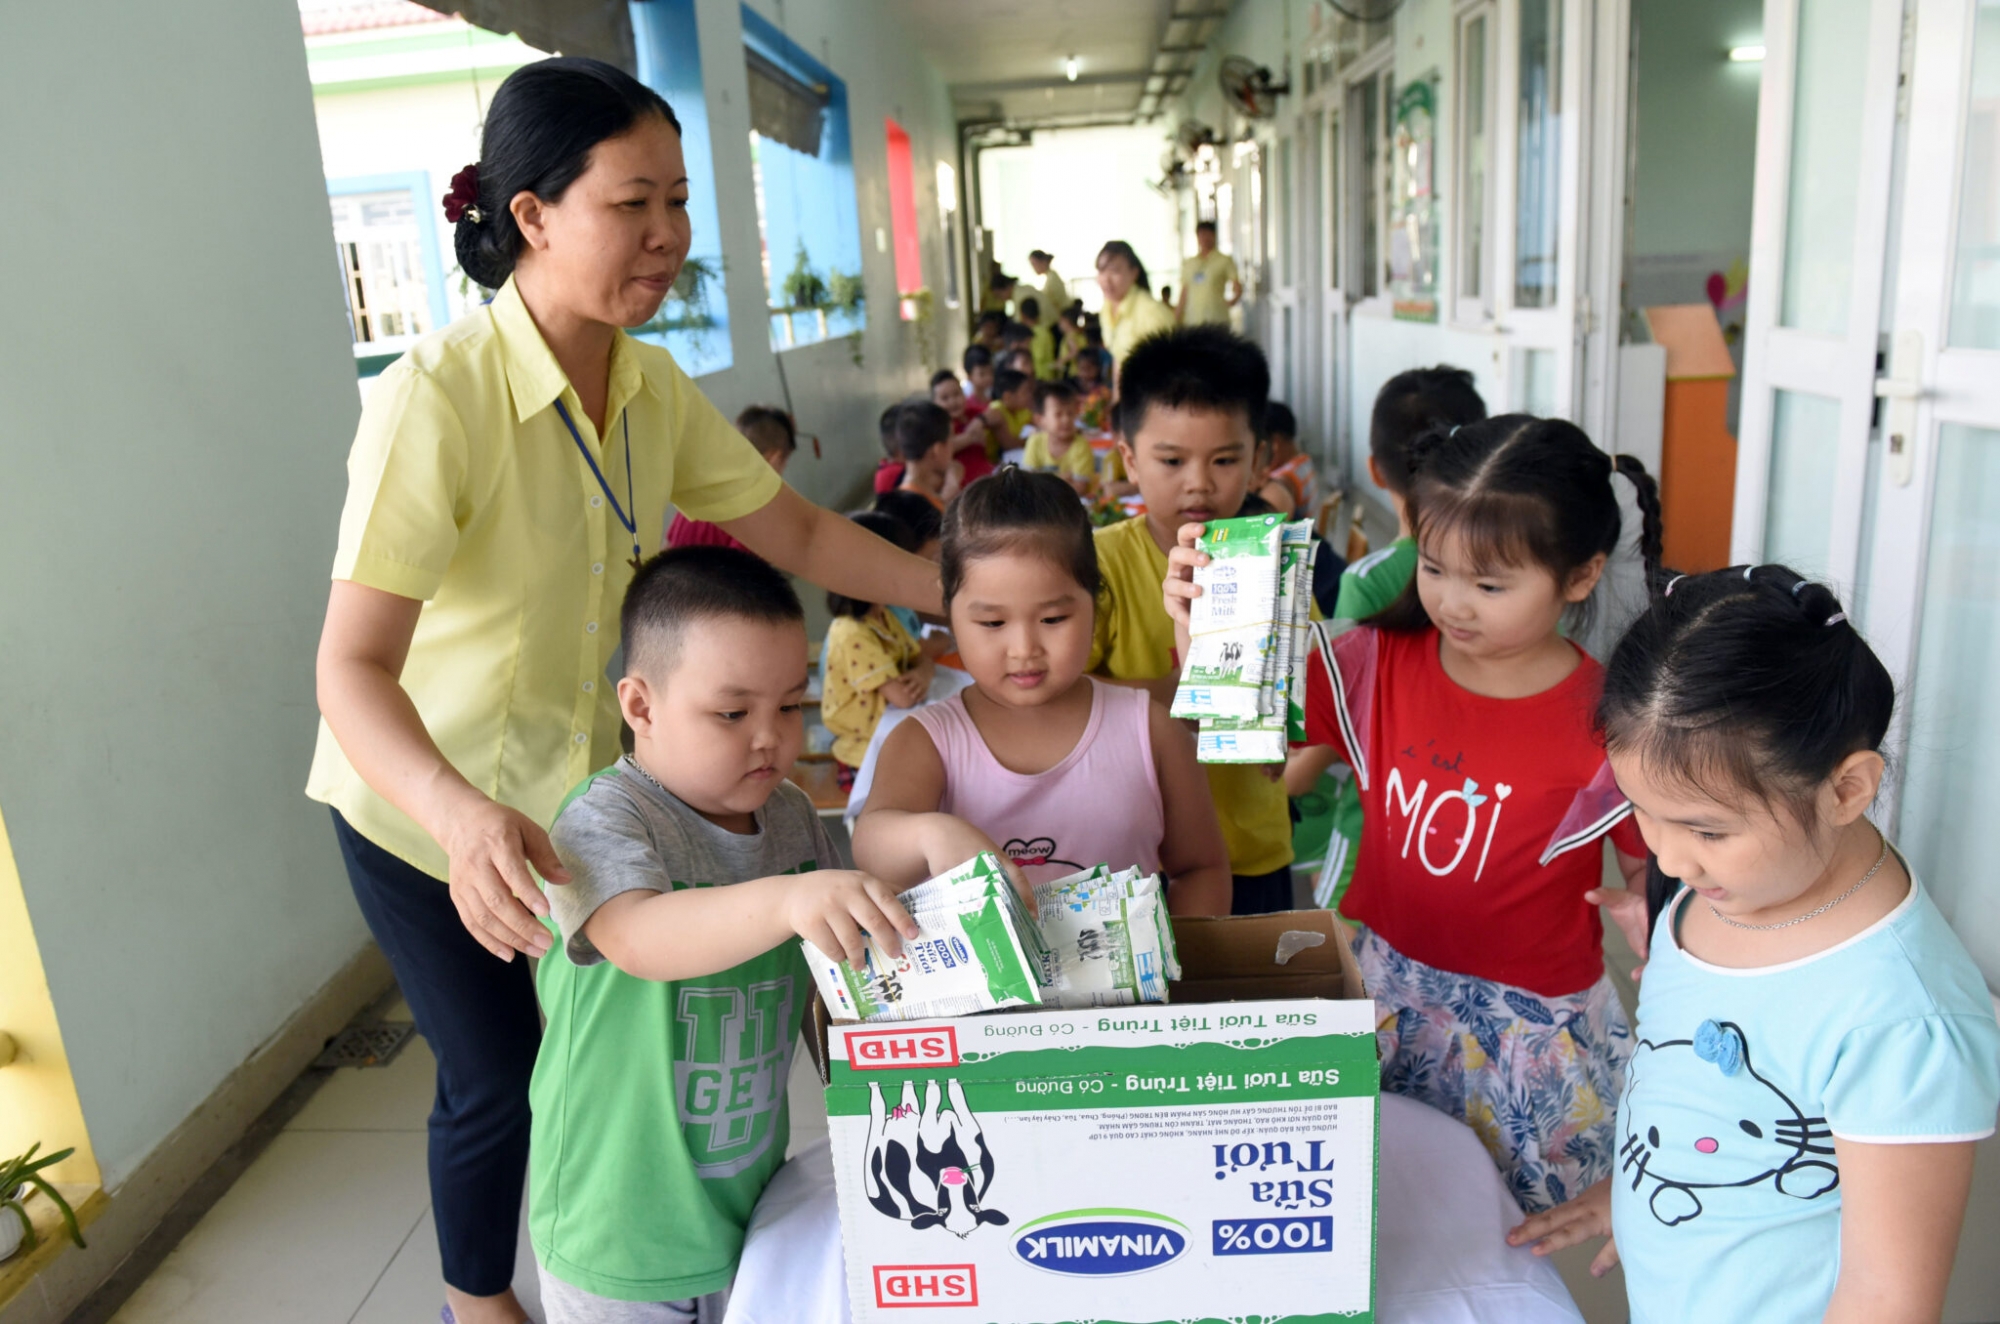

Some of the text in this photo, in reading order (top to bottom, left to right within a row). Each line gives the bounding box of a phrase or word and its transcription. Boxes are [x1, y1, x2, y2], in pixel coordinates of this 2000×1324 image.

[1211, 606, 1235, 617] Milk
[1008, 846, 1050, 857] meow
[934, 939, 956, 968] 100%
[1098, 1018, 1163, 1034] Trùng
[1170, 1015, 1212, 1032] Tiệt
[1219, 1014, 1267, 1030] Tươi
[1275, 1013, 1318, 1026] Sữa
[984, 1024, 1043, 1038] Đường
[1049, 1023, 1074, 1035] Có
[1125, 1074, 1191, 1094] Trùng
[1196, 1072, 1237, 1092] Tiệt
[1244, 1071, 1292, 1089] Tươi
[1298, 1068, 1340, 1087] Sữa
[1015, 1080, 1073, 1096] Đường
[1078, 1079, 1105, 1095] Có
[1212, 1140, 1335, 1180] Tươi
[1249, 1178, 1334, 1210] Sữa
[1218, 1221, 1327, 1251] 100%
[1024, 1233, 1175, 1259] VINAMILK
